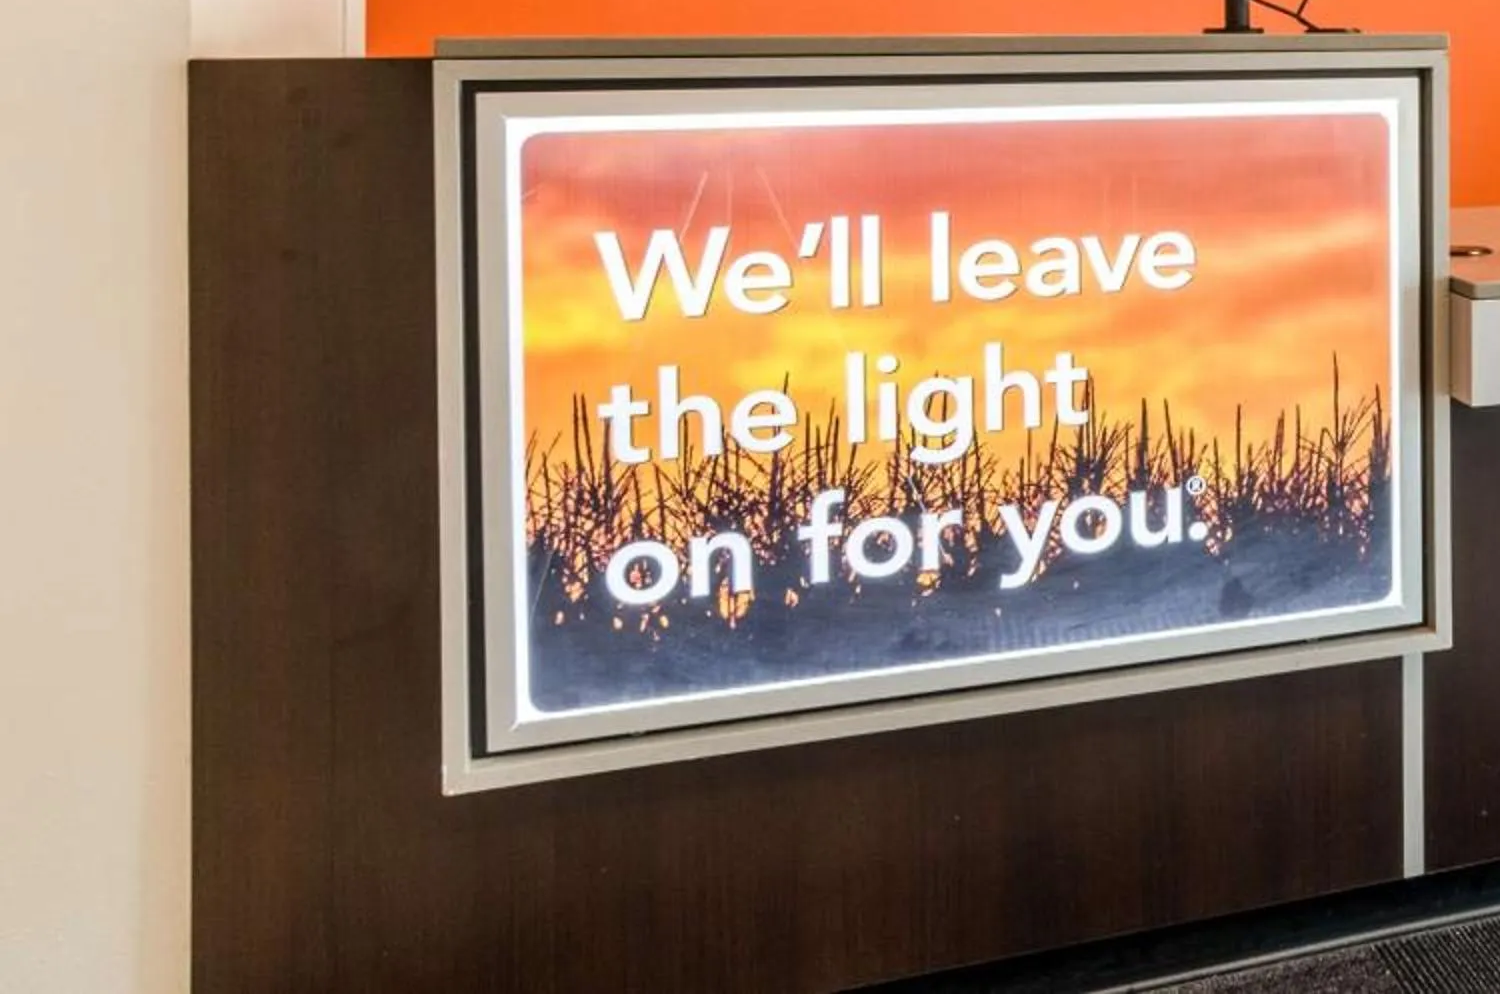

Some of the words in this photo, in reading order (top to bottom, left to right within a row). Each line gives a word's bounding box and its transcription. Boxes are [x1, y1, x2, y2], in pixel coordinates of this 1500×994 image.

[593, 213, 881, 322] We’ll
[930, 211, 1198, 302] leave
[596, 364, 798, 464] the
[845, 341, 1093, 464] light
[604, 528, 754, 606] on
[797, 488, 964, 585] for
